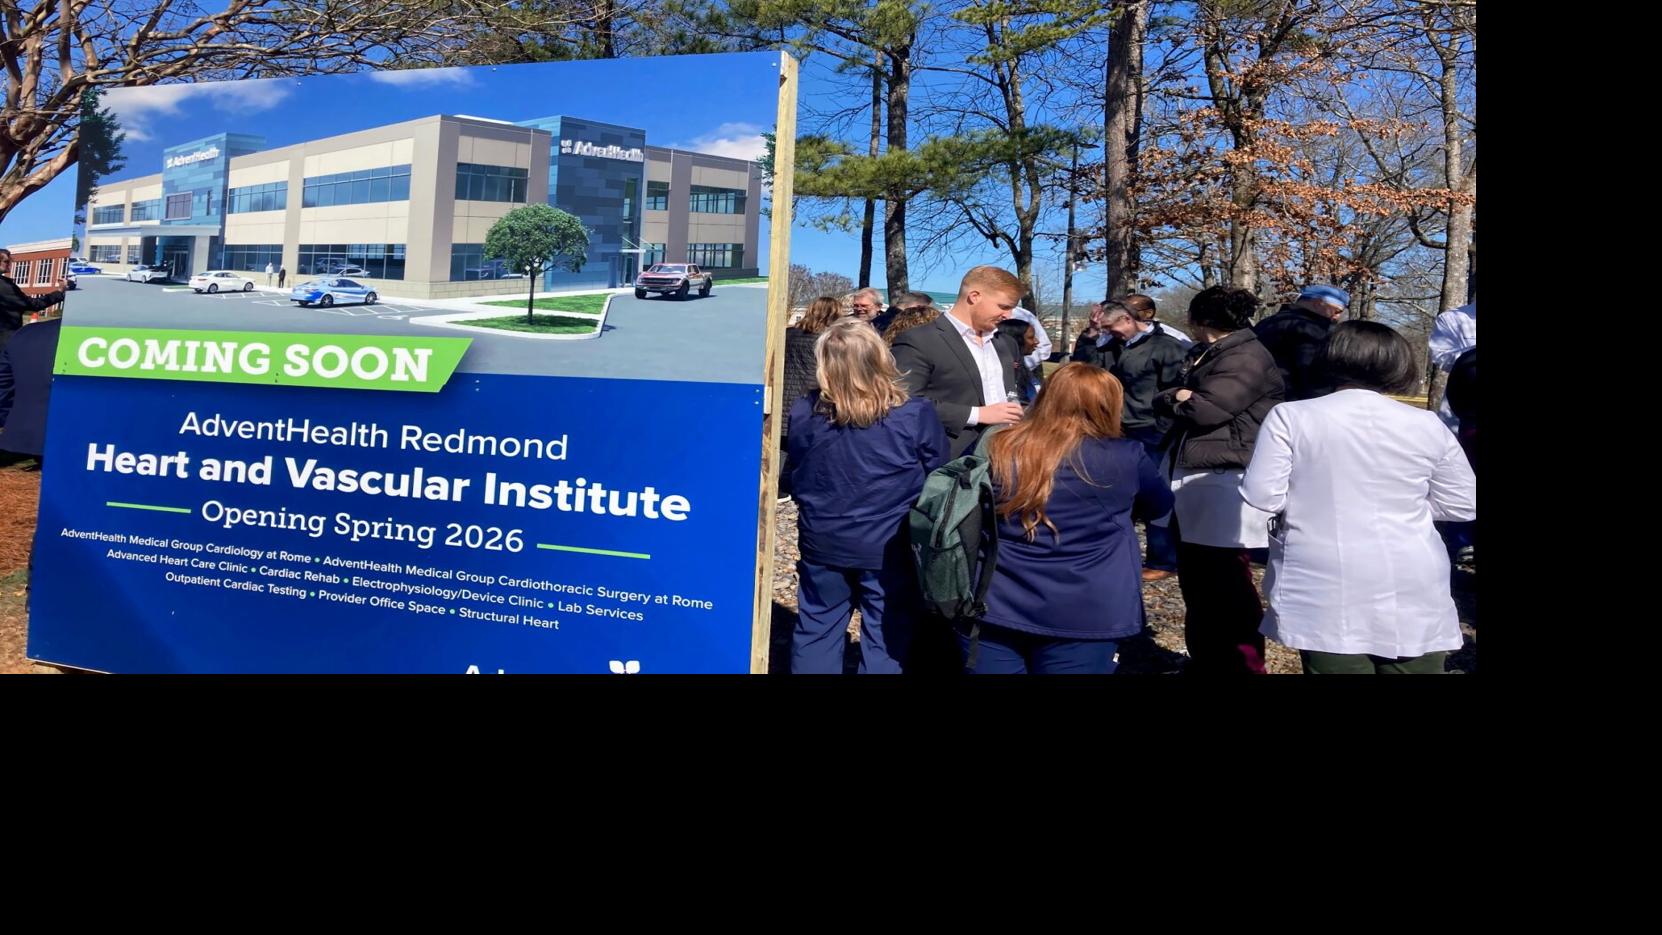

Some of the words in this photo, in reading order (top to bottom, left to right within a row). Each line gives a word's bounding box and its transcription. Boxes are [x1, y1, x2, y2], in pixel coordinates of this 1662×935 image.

[77, 337, 270, 375] COMING
[284, 344, 432, 382] SOON
[179, 412, 387, 448] AdventHealth
[401, 425, 567, 460] Redmond
[87, 443, 189, 478] Heart
[200, 456, 272, 485] and
[285, 457, 470, 501] Vascular
[485, 473, 690, 520] Institute
[202, 501, 326, 537] Opening
[335, 513, 436, 549] Spring
[445, 523, 523, 552] 2026
[60, 528, 127, 544] AdventHealth
[129, 535, 169, 548] Medical
[170, 540, 204, 553] Group
[205, 543, 264, 560] Cardiology
[265, 551, 278, 560] at
[279, 551, 312, 564] Rome
[322, 556, 403, 574] AdventHealth
[405, 565, 453, 580] Medical
[455, 571, 495, 586] Group
[498, 576, 594, 596] Cardiothoracic
[597, 587, 651, 605] Surgery
[654, 595, 669, 605] at
[672, 595, 713, 610] Rome
[106, 549, 158, 563] Advanced
[159, 555, 189, 567] Heart
[190, 559, 216, 570] Care
[218, 561, 248, 574] Clinic
[259, 566, 302, 580] Cardiac
[304, 571, 341, 584] Rehab
[352, 577, 505, 604] Electrophysiology/Device
[508, 596, 544, 609] Clinic
[558, 601, 583, 614] Lab
[585, 605, 644, 621] Services
[165, 572, 221, 588] Outpatient
[223, 579, 265, 593] Cardiac
[267, 584, 307, 600] Testing
[318, 590, 368, 605] Provider
[369, 596, 405, 610] Office
[408, 601, 446, 615] Space
[458, 608, 520, 625] Structural
[522, 616, 559, 630] Heart
